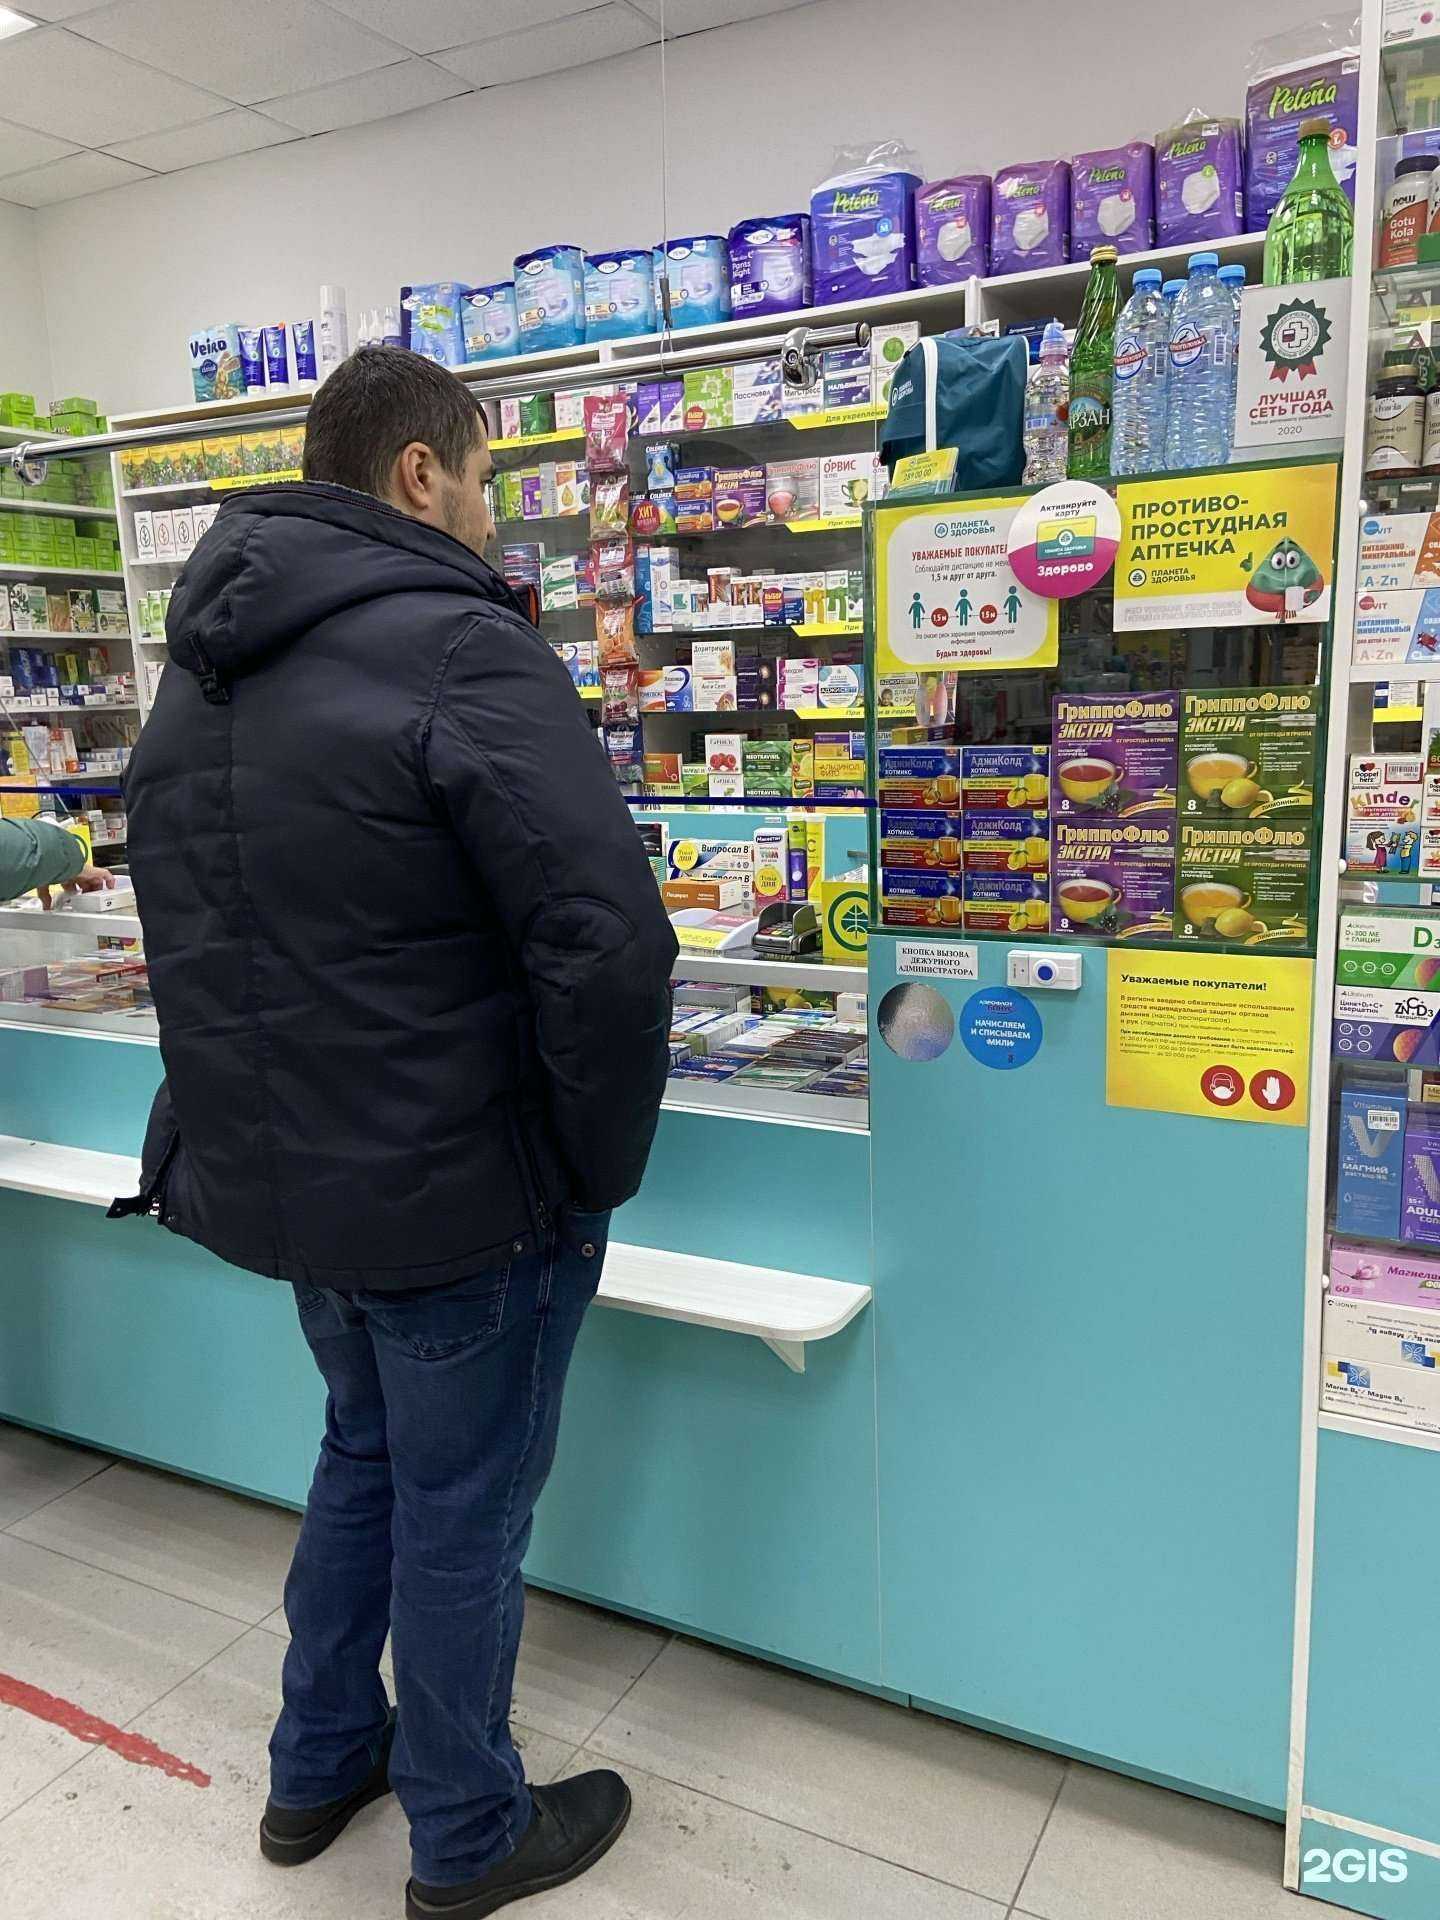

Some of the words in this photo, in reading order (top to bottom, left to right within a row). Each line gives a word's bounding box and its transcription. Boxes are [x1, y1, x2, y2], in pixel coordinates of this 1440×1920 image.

[1390, 216, 1416, 229] Gotu
[1390, 228, 1414, 240] Kola
[190, 337, 228, 359] Veiro
[1258, 388, 1327, 406] ЛУЧШАЯ
[1249, 404, 1288, 419] СЕТЬ
[1292, 400, 1334, 415] ГОДА
[1278, 425, 1303, 436] 2020
[824, 459, 857, 473] ОРВИС
[1040, 499, 1097, 513] Активируйте
[1132, 494, 1249, 520] ПРОТИВО-
[638, 506, 654, 519] ХИТ
[1054, 508, 1080, 519] карту
[950, 519, 990, 529] ПЛАНЕТА
[1131, 512, 1288, 541] ПРОСТУДНАЯ
[950, 527, 995, 538] ЗДОРОВЬЯ
[912, 546, 963, 562] УВАЖАЕМЫЕ
[1130, 538, 1236, 562] АПТЕЧКА
[914, 562, 951, 574] Соблюдайте
[950, 561, 985, 573] дистанцию
[986, 562, 997, 570] не
[1036, 562, 1094, 578] Здорово
[1151, 568, 1189, 577] ПЛАНЕТА
[949, 573, 965, 584] друг
[966, 572, 975, 580] от
[975, 570, 998, 582] друга.
[1151, 575, 1196, 585] ЗДОРОВЬЯ
[935, 649, 959, 660] Будьте
[958, 647, 992, 659] здоровы!
[1185, 692, 1311, 716] ГриппоФлю
[1058, 700, 1173, 722] ГриппоФлю
[1058, 722, 1113, 739] ЭКСТРА
[1185, 716, 1246, 733] ЭКСТРА
[971, 756, 1024, 768] АджиКолд
[1354, 771, 1379, 781] Doppel
[1061, 799, 1070, 810] 8
[1187, 799, 1196, 810] 8
[971, 820, 1025, 832] АджиКолд
[887, 829, 915, 837] ХОТМИКС
[1057, 825, 1170, 845] ГриппоФлю
[1182, 826, 1305, 846] ГриппоФлю
[701, 844, 742, 856] Випросал
[1057, 845, 1111, 861] ЭКСТРА
[1182, 847, 1241, 864] ЭКСТРА
[889, 887, 916, 895] ХОТМИКС
[1060, 918, 1069, 929] 8
[1184, 924, 1193, 935] 8
[1352, 936, 1381, 944] ГЛИЦИН
[902, 948, 935, 958] КНОПКА
[936, 950, 969, 959] ВЫЗОВА
[910, 956, 961, 967] ДЕЖУРНОГО
[898, 965, 974, 976] АДМИНИСТРАТОРА
[1121, 974, 1190, 987] Уважаемые
[1192, 979, 1267, 992] покупатели!
[1126, 996, 1155, 1004] регионе
[1187, 999, 1238, 1009] обязательное
[1238, 1003, 1296, 1012] использование
[1120, 1011, 1150, 1019] дыхания
[1149, 1005, 1208, 1015] индивидуальной
[1209, 1009, 1237, 1017] защиты
[975, 1019, 1026, 1030] НАЧИСЛЯЕМ
[1126, 1019, 1139, 1027] рук
[978, 1029, 1031, 1039] СПИСЫВАЕМ
[1342, 1163, 1388, 1174] МАГНИЙ
